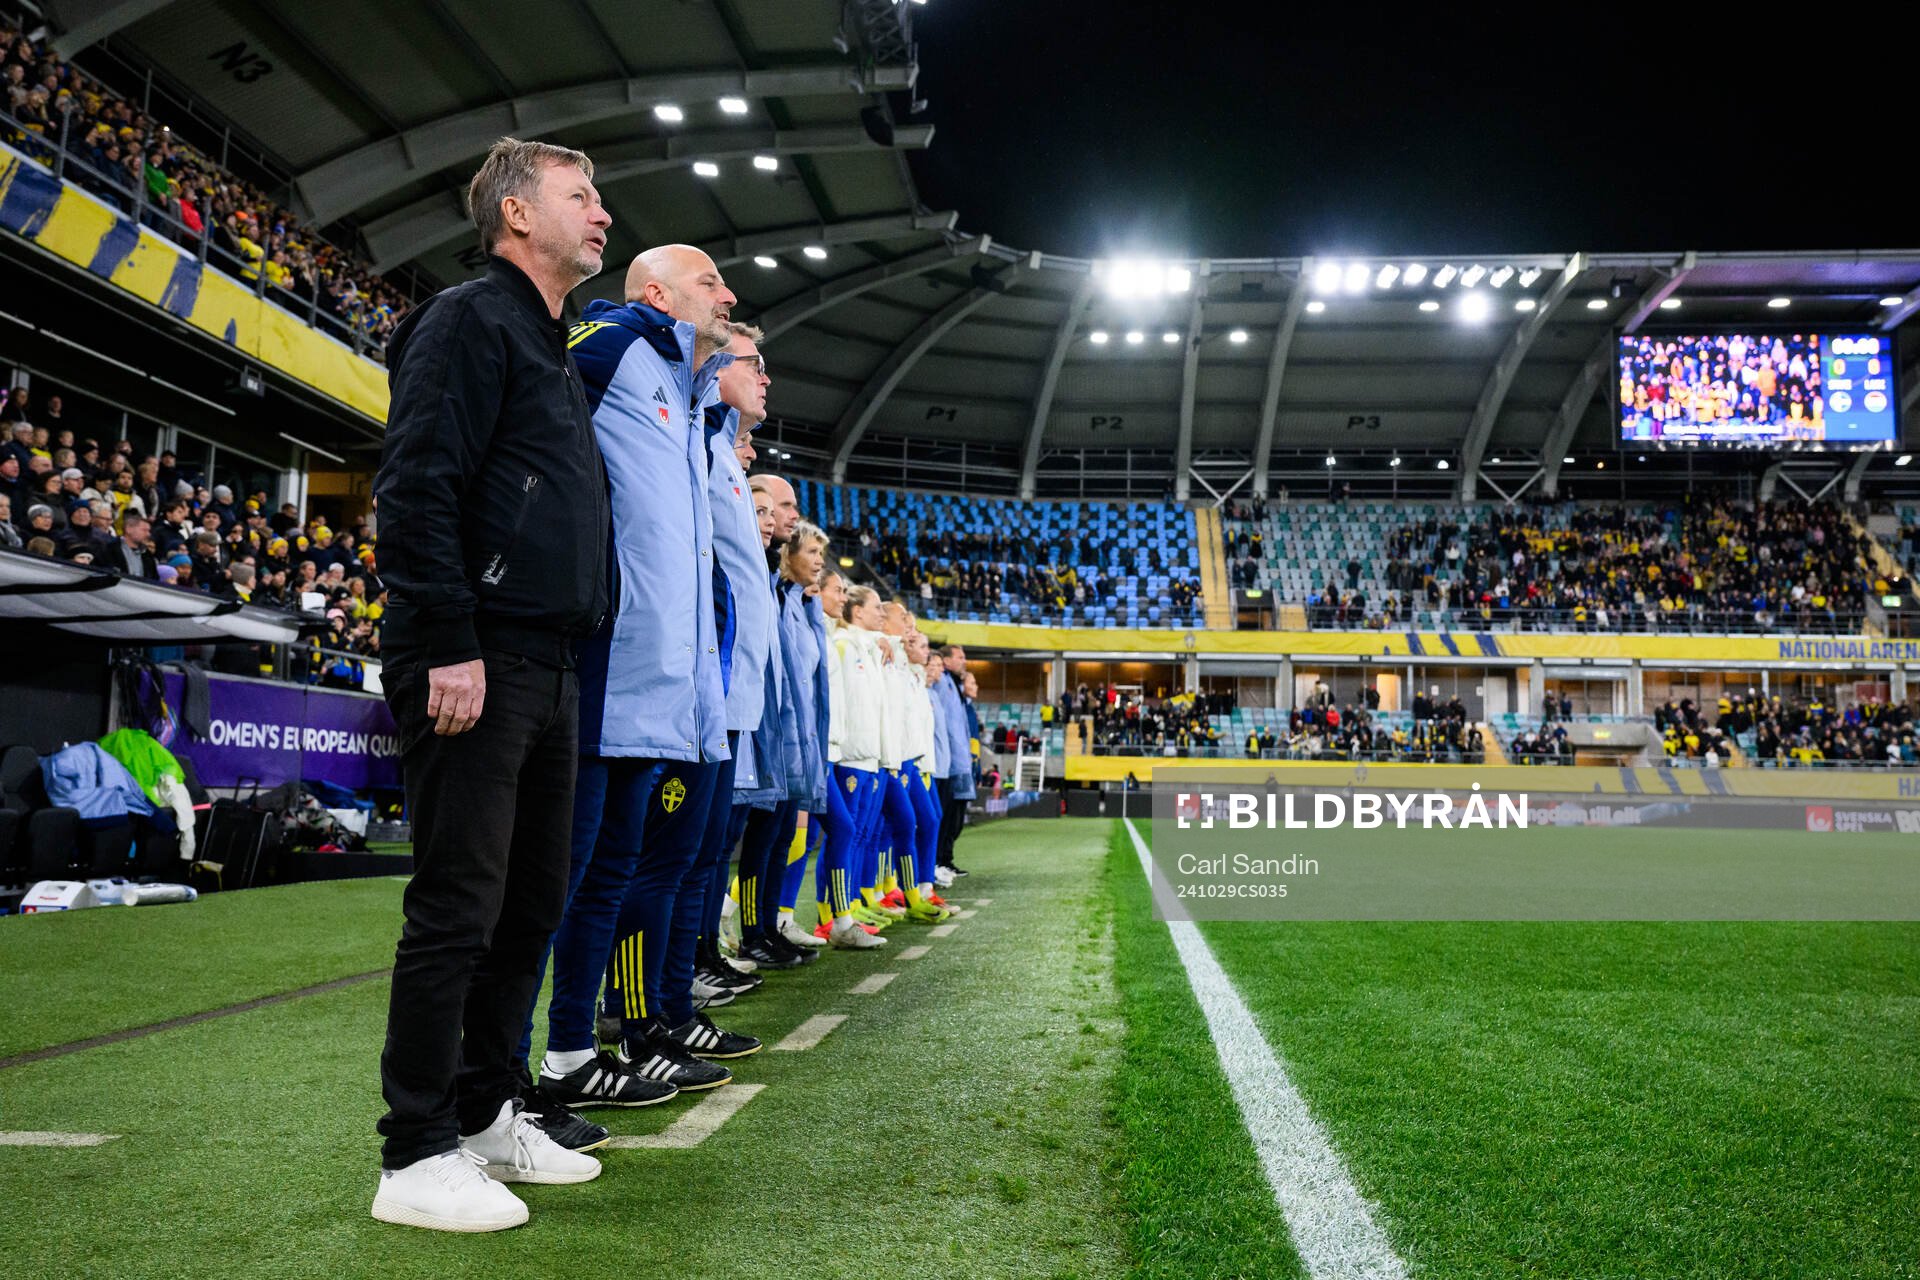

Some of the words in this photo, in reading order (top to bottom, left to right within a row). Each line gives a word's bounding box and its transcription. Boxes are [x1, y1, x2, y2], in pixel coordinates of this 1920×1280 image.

[207, 41, 273, 82] N3
[925, 406, 959, 422] P1
[1090, 415, 1125, 431] P2
[1346, 415, 1382, 431] P3
[1779, 641, 1920, 659] NATIONALAREN
[193, 719, 280, 750] OMEN'S
[283, 726, 368, 755] EUROPEAN
[1835, 811, 1893, 824] SVENSKA
[1835, 822, 1864, 832] SPEL
